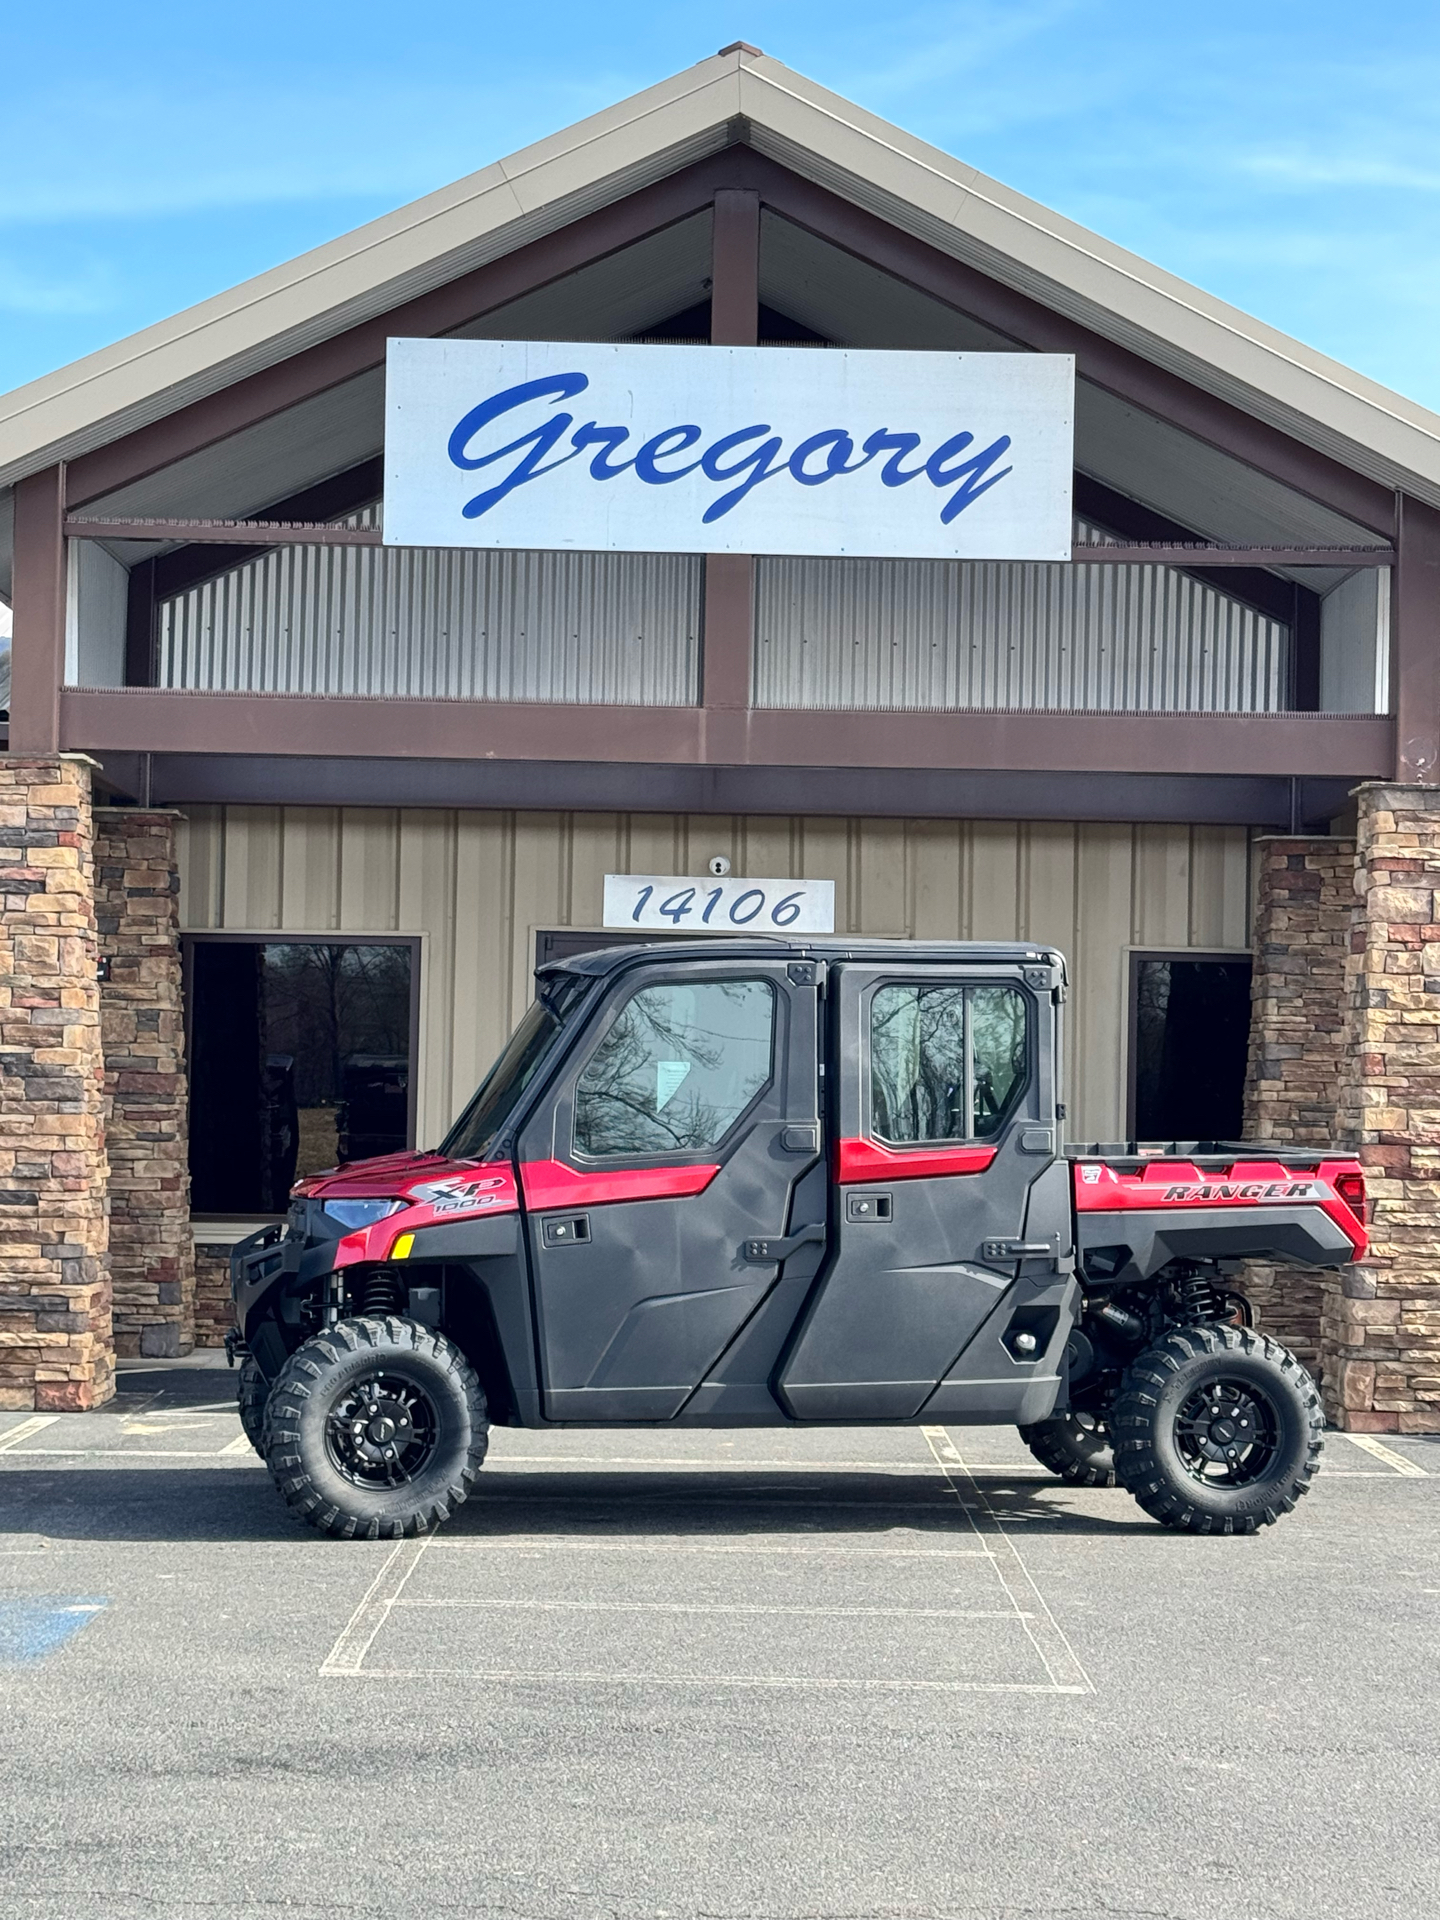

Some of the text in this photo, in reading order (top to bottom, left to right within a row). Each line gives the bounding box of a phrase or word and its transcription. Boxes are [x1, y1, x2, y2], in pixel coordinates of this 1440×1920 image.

[448, 372, 1013, 525] Gregory
[632, 885, 806, 927] 14106
[424, 1177, 506, 1204] XP
[435, 1195, 495, 1213] 1000
[1162, 1182, 1314, 1201] RANGER
